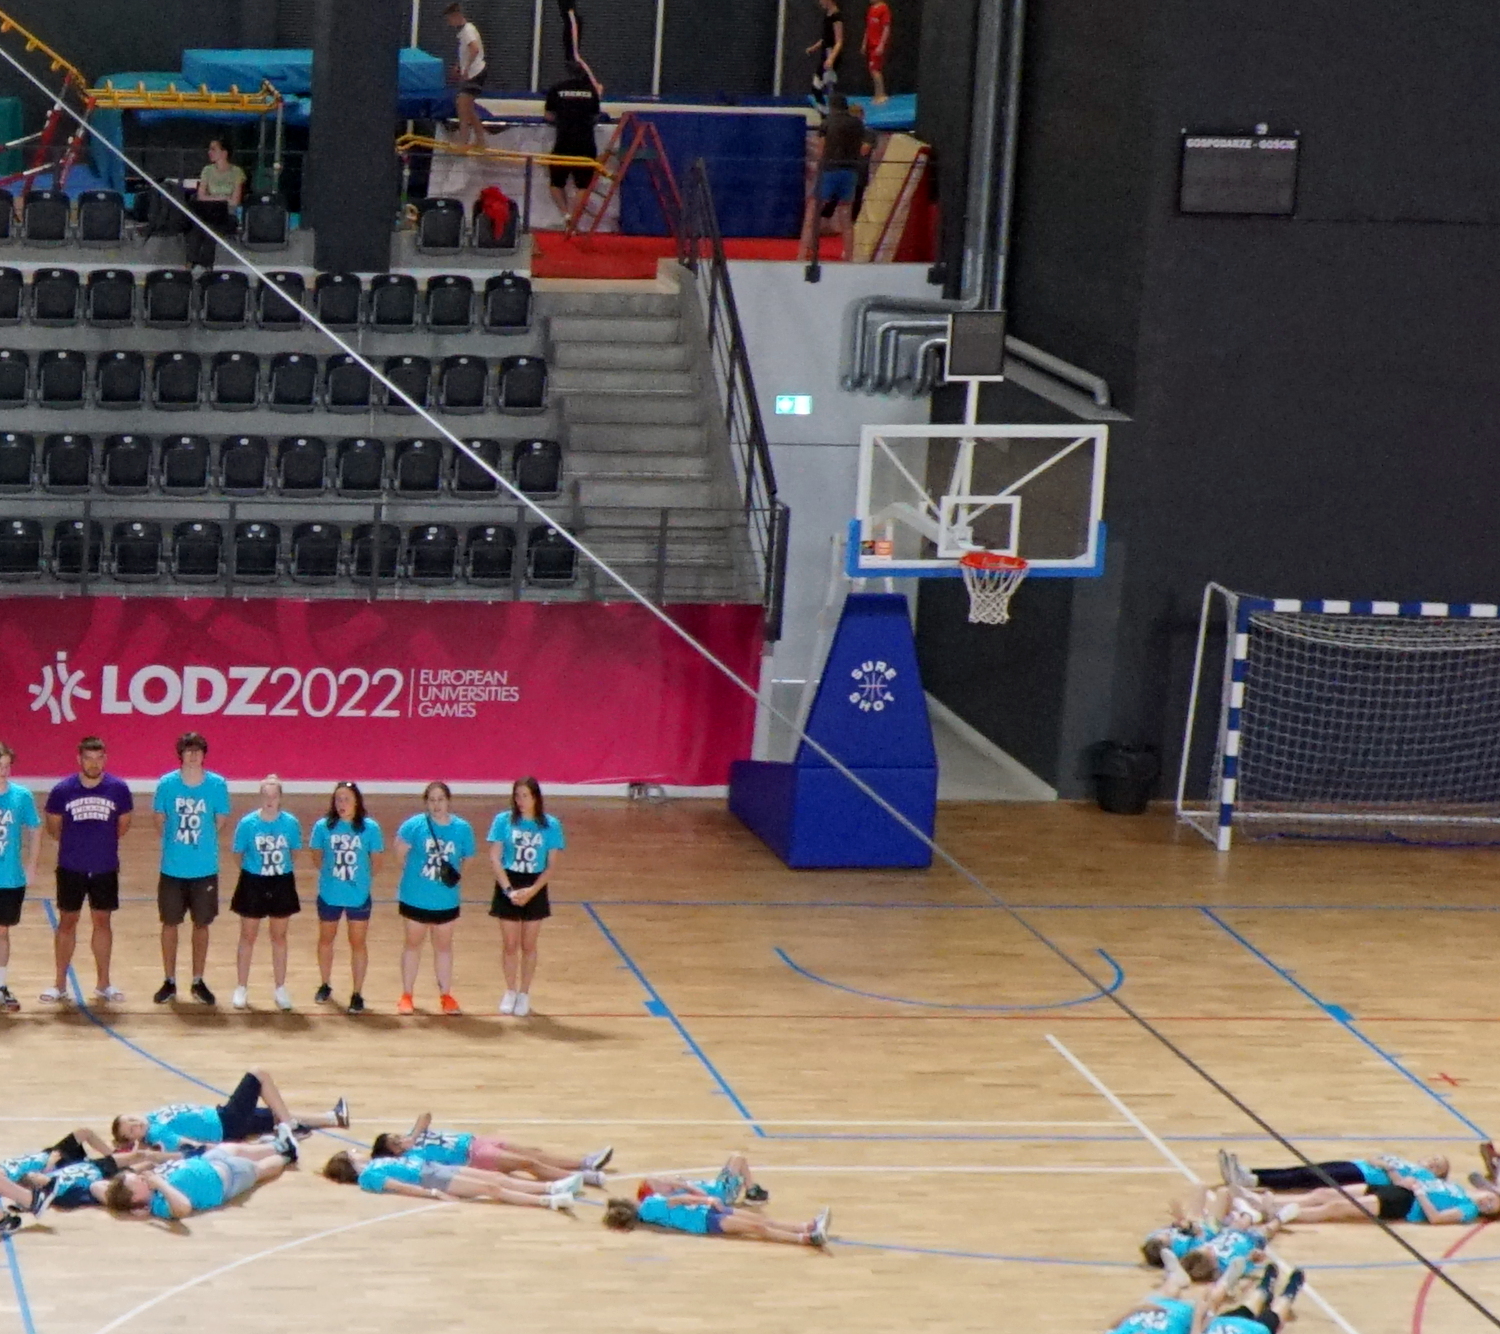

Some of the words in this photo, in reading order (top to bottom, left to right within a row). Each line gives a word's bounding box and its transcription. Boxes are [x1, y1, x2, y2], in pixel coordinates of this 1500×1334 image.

[419, 669, 509, 686] EUROPEAN
[851, 660, 897, 681] SURE
[101, 664, 404, 718] LODZ2022
[418, 685, 520, 703] UNIVERSITIES
[418, 701, 477, 718] GAMES
[849, 691, 895, 713] SHOT
[175, 797, 207, 814] PSA
[178, 814, 201, 829] TO
[174, 829, 202, 846] MY
[254, 833, 288, 851] PSA
[329, 833, 362, 850] PSA
[511, 829, 543, 846] PSA
[260, 850, 284, 865] TO
[334, 850, 357, 865] TO
[514, 845, 537, 861] TO
[332, 865, 359, 881] MY
